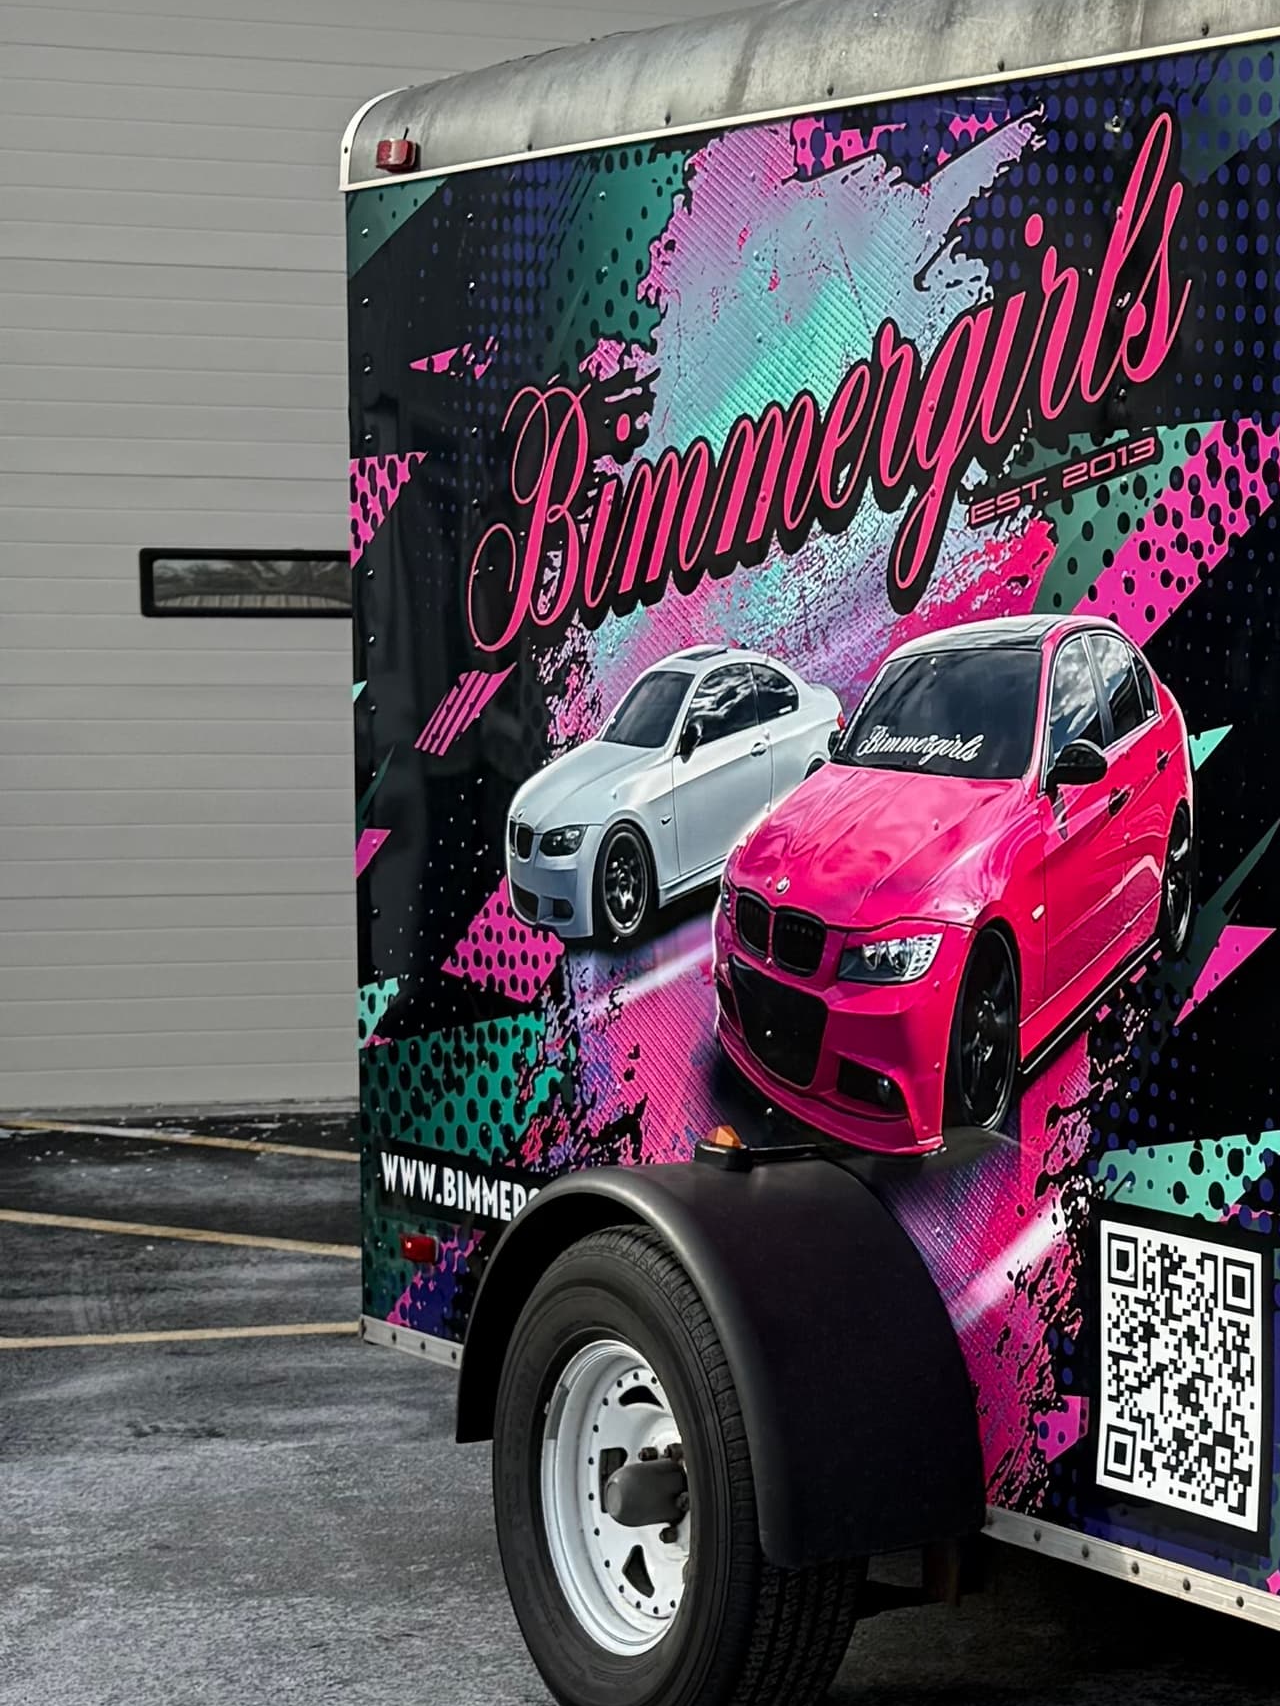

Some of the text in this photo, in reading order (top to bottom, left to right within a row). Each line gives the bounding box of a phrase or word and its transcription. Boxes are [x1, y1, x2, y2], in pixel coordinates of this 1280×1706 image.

[466, 112, 1192, 651] Bimmergirls
[970, 437, 1155, 524] EST. 2013
[856, 725, 985, 765] Bimmergirls
[381, 1152, 540, 1222] WWW.BIMMER
